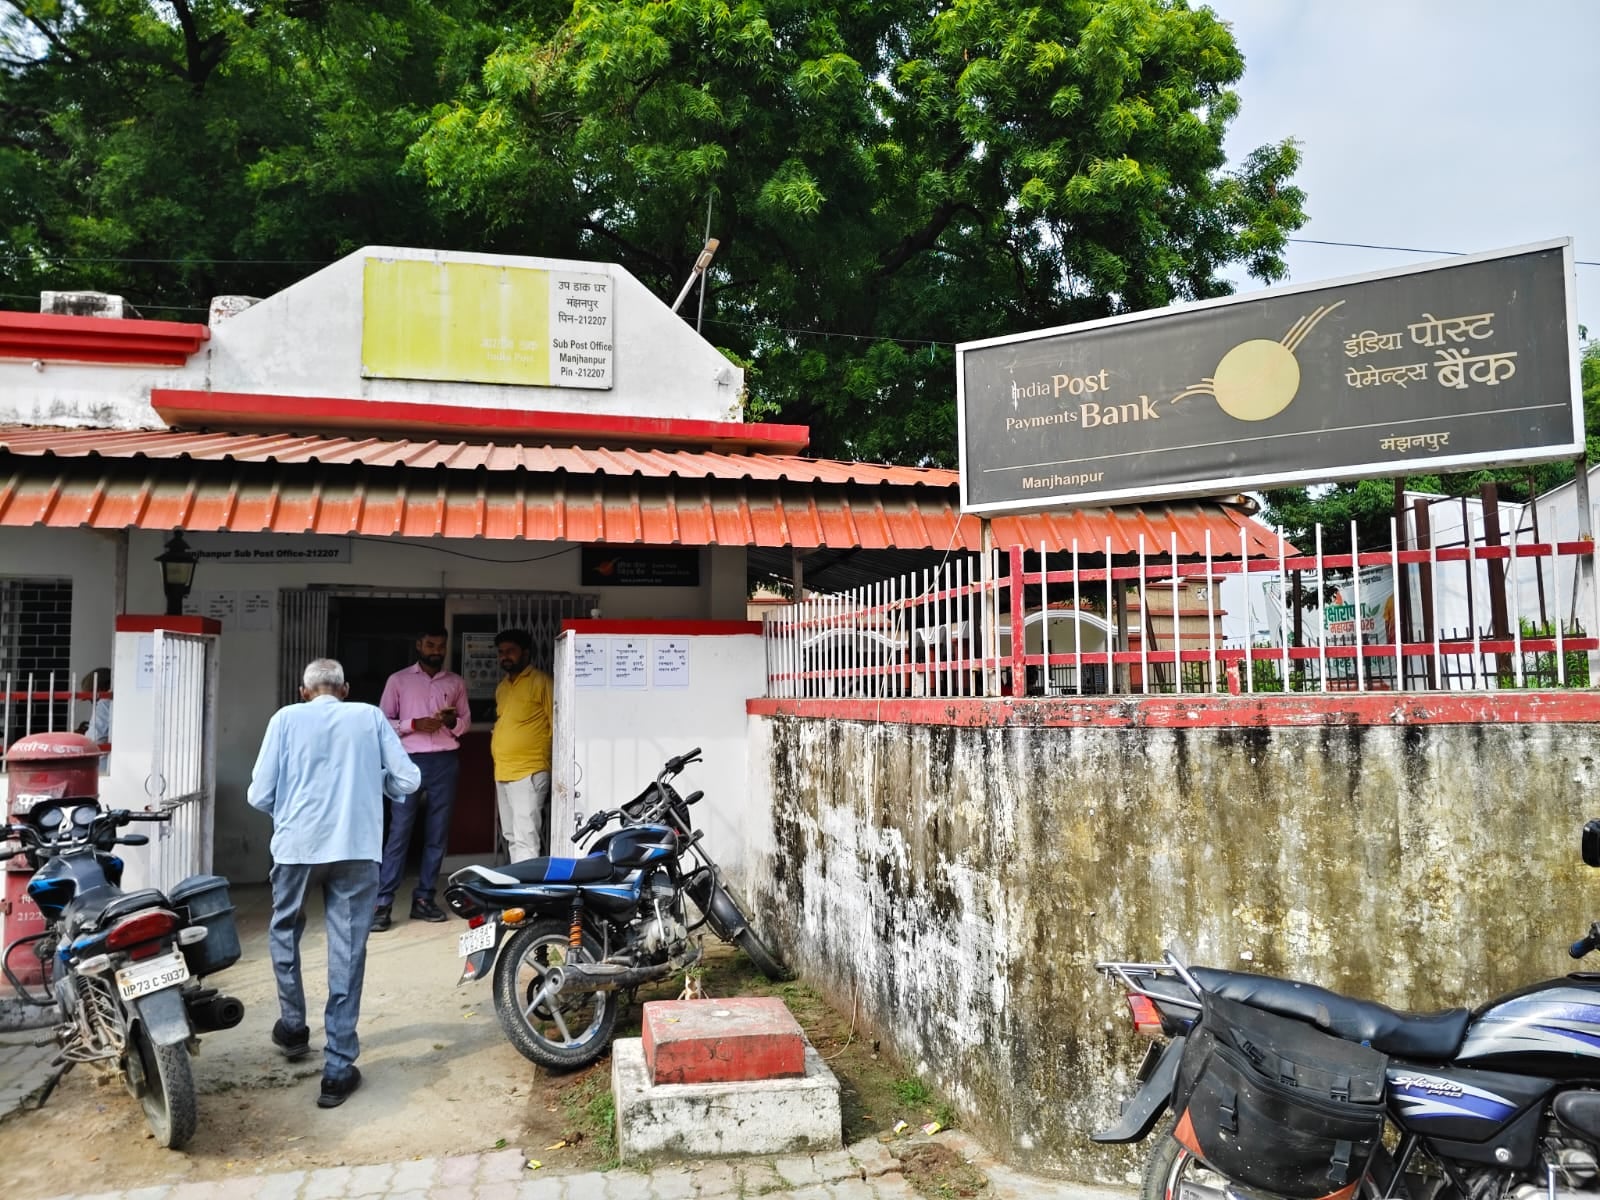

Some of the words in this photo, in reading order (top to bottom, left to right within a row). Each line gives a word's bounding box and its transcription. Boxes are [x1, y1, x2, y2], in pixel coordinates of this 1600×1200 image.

[558, 281, 570, 291] उप
[573, 282, 592, 292] डाक
[593, 283, 607, 294] घर
[566, 295, 600, 312] मंझनपुर
[558, 311, 607, 326] पिन-212207
[1343, 330, 1403, 358] इंडिया
[1407, 312, 1495, 347] पोस्ट
[552, 338, 569, 349] Sub
[570, 339, 588, 350] Post
[589, 340, 614, 352] Office
[559, 352, 606, 366] Manjhanpur
[560, 366, 573, 376] Pin
[1433, 347, 1518, 389] बैंक
[1011, 381, 1051, 401] India
[1052, 368, 1110, 398] Post
[1006, 409, 1078, 432] Payments
[1080, 395, 1160, 428] Bank
[1379, 431, 1451, 453] मंझनपुर
[1022, 471, 1104, 490] Manjhanpur
[234, 549, 251, 558] Sub
[254, 549, 274, 558] Post
[276, 549, 339, 558] Office-212207
[1361, 618, 1375, 631] 026
[152, 977, 160, 987] C
[161, 968, 185, 985] 5037
[1388, 1076, 1463, 1092] Splendor
